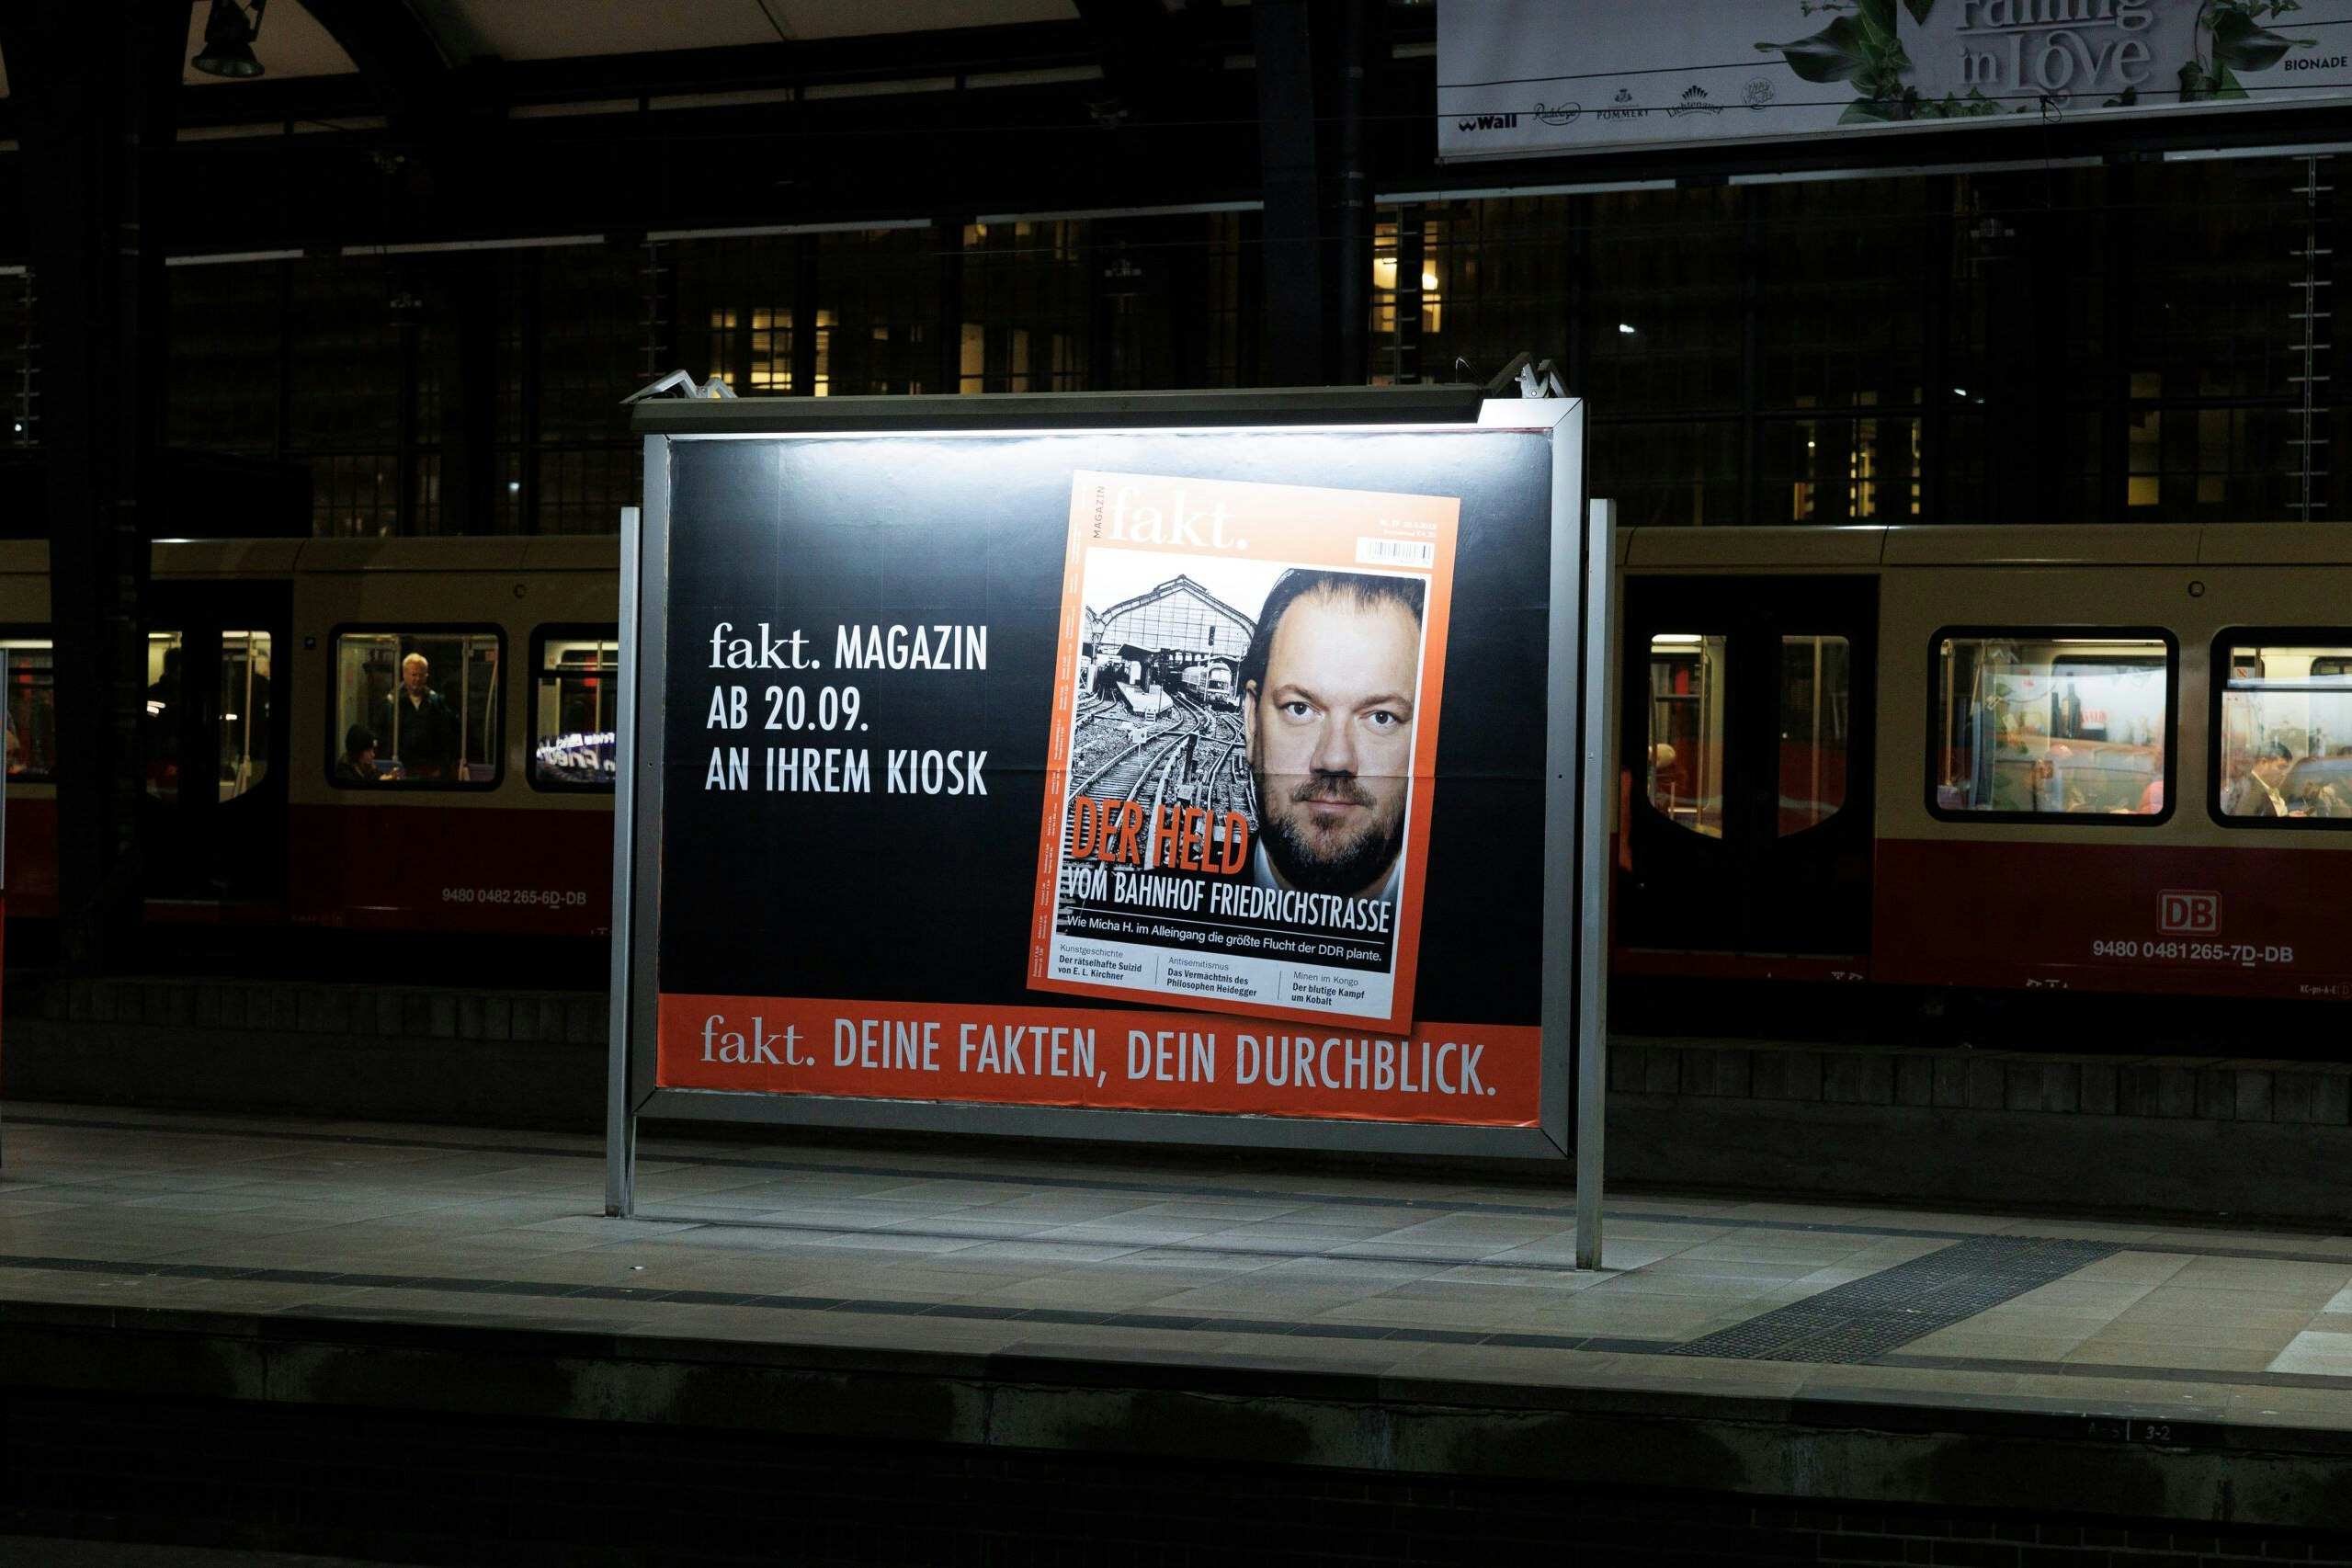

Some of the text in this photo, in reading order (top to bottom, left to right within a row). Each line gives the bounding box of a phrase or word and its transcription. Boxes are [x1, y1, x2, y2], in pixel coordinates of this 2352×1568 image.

[1959, 46, 1999, 85] in
[2285, 57, 2348, 72] BIONADE
[1477, 112, 1517, 130] Wall
[1093, 485, 1106, 539] MAGAZIN
[1108, 485, 1248, 551] fakt.
[709, 622, 987, 670] fakt. MAGAZIN
[706, 686, 869, 732] AB 20.09.
[705, 747, 988, 796] AN IHREM KIOSK
[1071, 796, 1142, 866] DER
[1153, 804, 1248, 874] HELD
[441, 888, 587, 907] 9480 0482 265-6D-DB
[1065, 867, 1108, 903] VOM
[1114, 870, 1206, 913] BAHNHOF
[1210, 882, 1392, 934] FRIEDRICHSTRASSE
[2164, 895, 2215, 930] DB
[1067, 915, 1382, 961] Wie Micha H. im Alleingang die größte Flucht der DDR plante.
[1060, 944, 1123, 959] Kunstgeschichte
[2093, 940, 2138, 958] 9480
[1059, 954, 1142, 972] Der rätselhafte Suizid
[1168, 956, 1229, 971] Antisemitismus
[1058, 966, 1124, 981] von E. L. Kirchner
[1167, 968, 1248, 985] Das Vermächtnis des
[1293, 971, 1358, 987] Minen im Kongo
[1166, 978, 1256, 997] Philosophen Heidegger
[1292, 983, 1365, 1000] Der blutige Kampf
[1291, 994, 1333, 1006] um Kobalt
[700, 1015, 1496, 1096] fakt. DEINE FAKTEN, DEIN DURCHBLICK.
